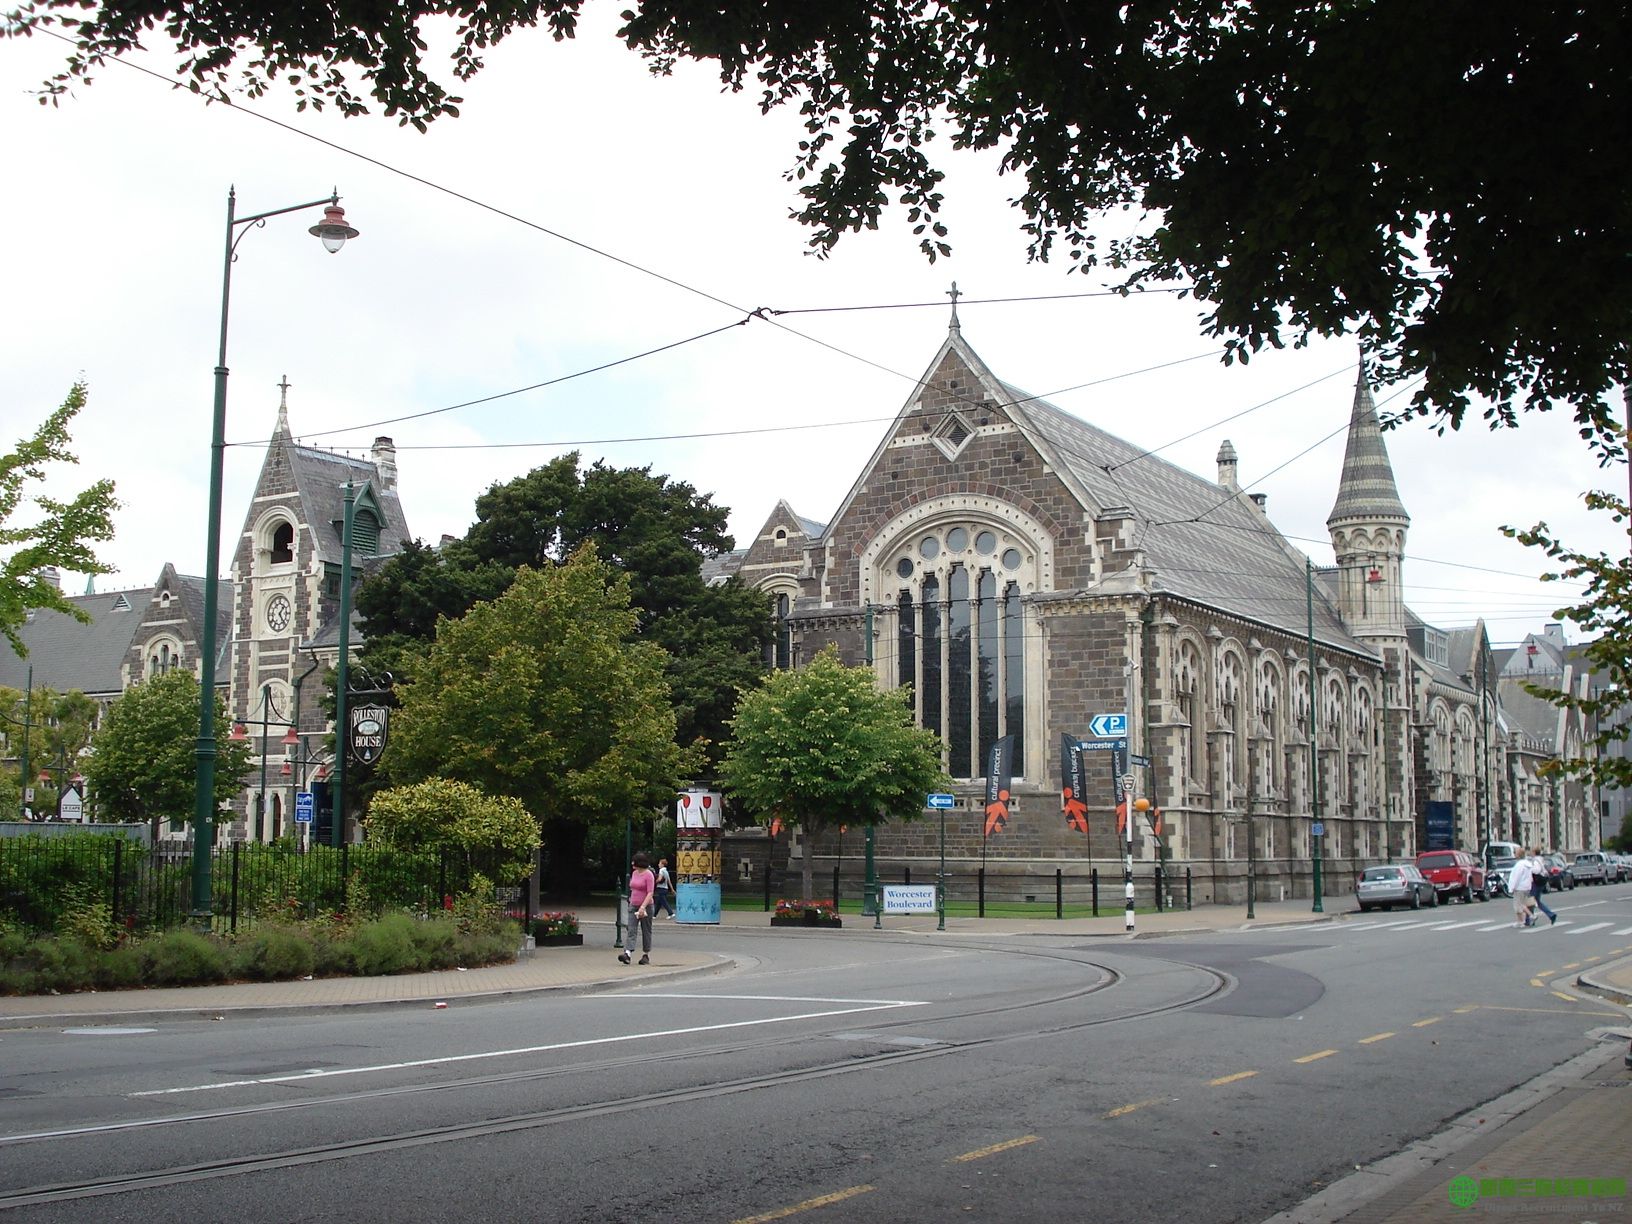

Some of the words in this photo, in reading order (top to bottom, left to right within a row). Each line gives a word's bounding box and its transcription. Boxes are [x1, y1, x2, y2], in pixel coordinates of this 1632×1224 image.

[353, 709, 385, 730] ROLLESTON
[1110, 717, 1120, 729] P
[355, 736, 382, 748] HOUSE
[1118, 740, 1126, 748] St
[993, 748, 1002, 775] precinct
[1114, 751, 1122, 777] precinct
[990, 775, 999, 801] cultural
[1115, 778, 1124, 802] cultural
[887, 890, 932, 898] Worcester
[887, 900, 932, 909] Boulevard
